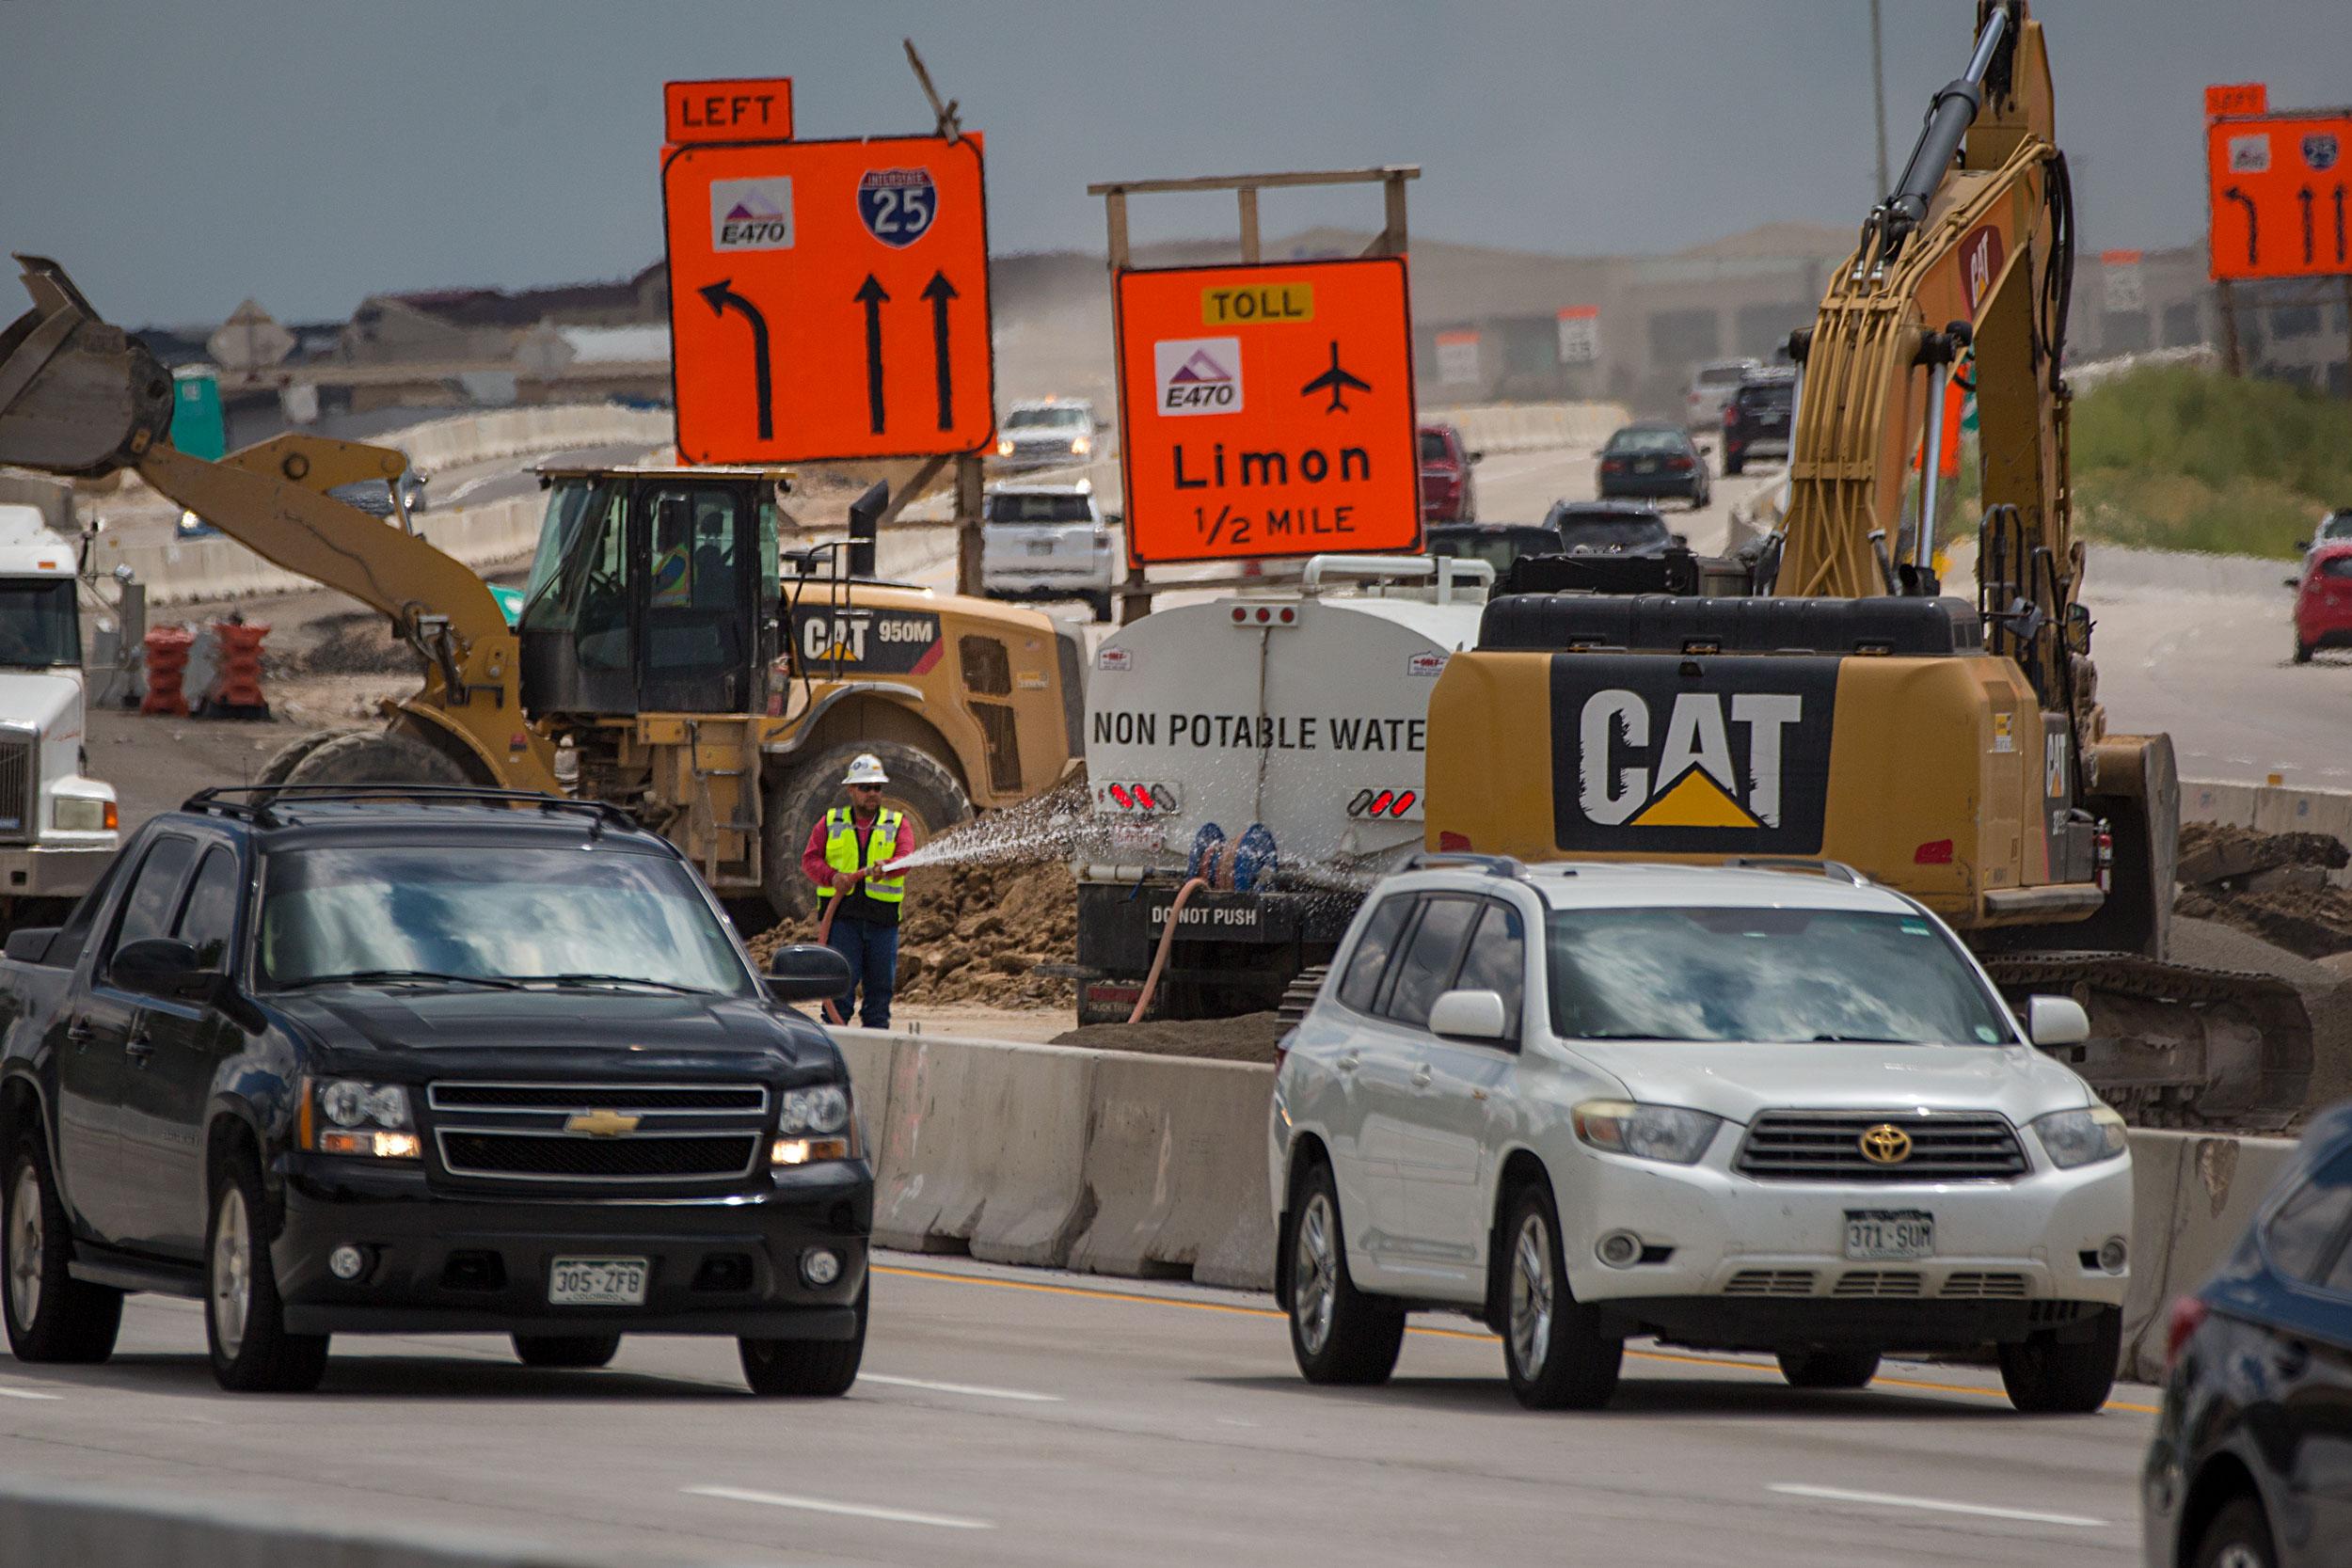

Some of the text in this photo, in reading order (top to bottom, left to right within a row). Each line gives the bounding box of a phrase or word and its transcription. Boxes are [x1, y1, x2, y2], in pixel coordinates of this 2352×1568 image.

[682, 95, 774, 127] LEFT
[872, 189, 929, 234] 25
[720, 222, 785, 245] E470
[1211, 290, 1303, 320] TOLL
[1165, 384, 1235, 409] E470
[1173, 443, 1371, 490] Limon
[1193, 505, 1356, 546] 1/2 MILE
[803, 617, 933, 661] CAT 950M
[1093, 711, 1156, 745] NON
[1168, 714, 1316, 750] POTABLE
[1579, 689, 1802, 829] CAT
[2046, 733, 2066, 798] CAT
[1179, 907, 1209, 925] NOT
[1213, 908, 1258, 927] PUSH
